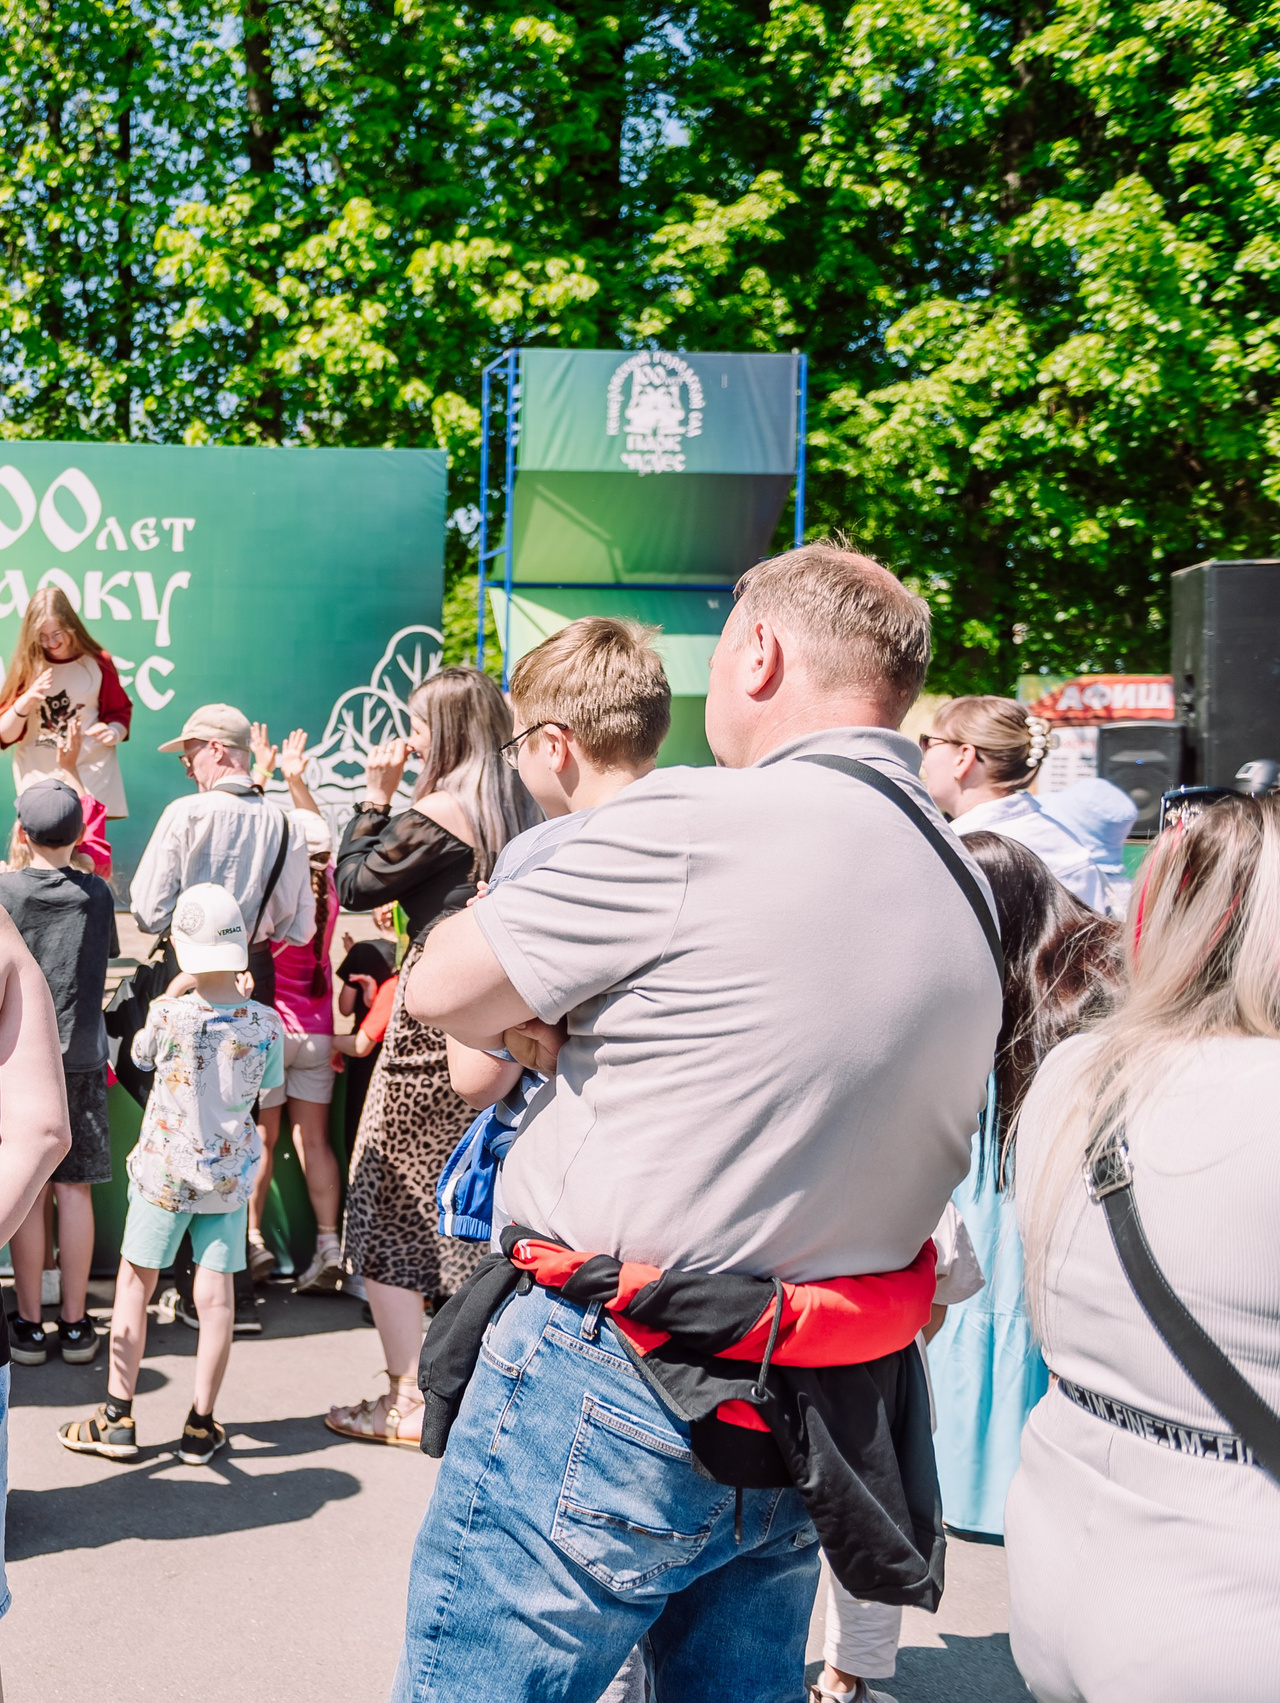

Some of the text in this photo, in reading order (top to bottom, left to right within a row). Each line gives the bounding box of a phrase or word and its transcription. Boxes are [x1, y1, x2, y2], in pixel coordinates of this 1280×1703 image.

[95, 516, 196, 552] ЛЕТ
[1055, 682, 1174, 710] АФИШ
[217, 926, 242, 936] VERSACE
[1111, 1400, 1159, 1443] FINE
[1216, 1435, 1254, 1465] FI
